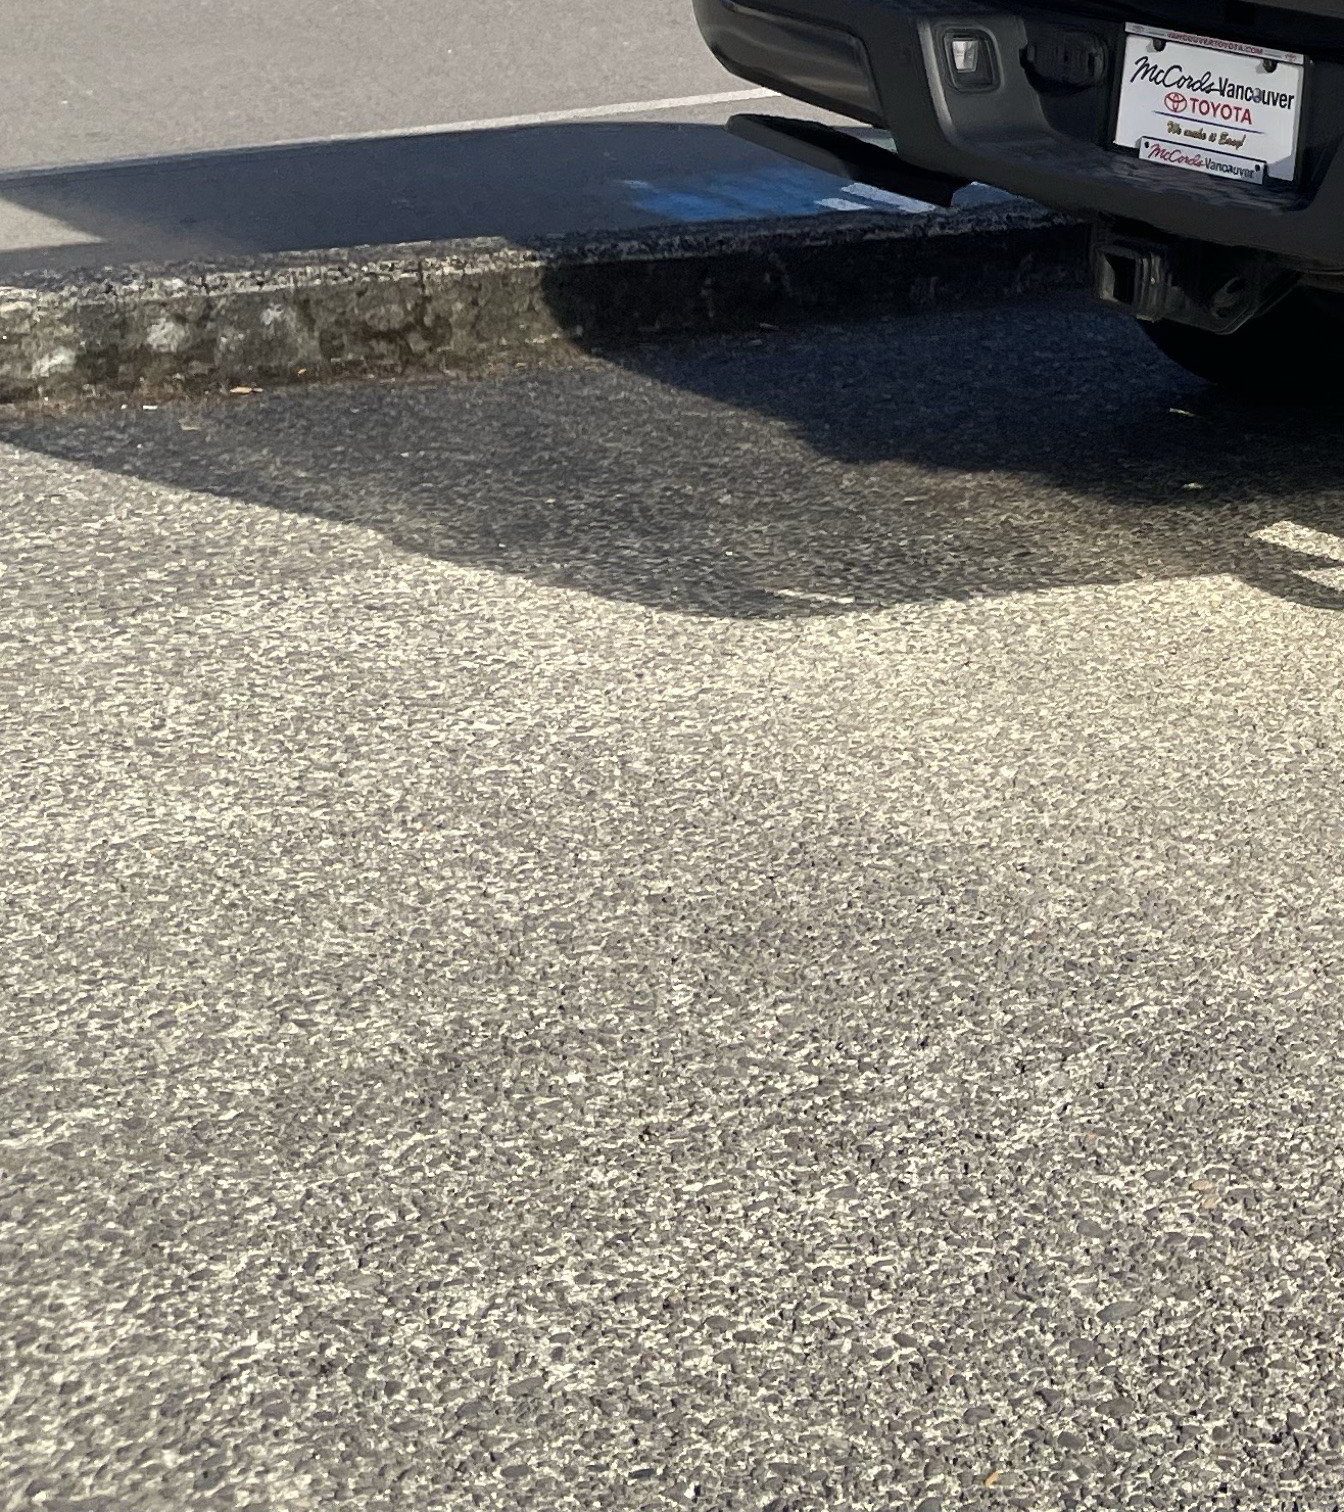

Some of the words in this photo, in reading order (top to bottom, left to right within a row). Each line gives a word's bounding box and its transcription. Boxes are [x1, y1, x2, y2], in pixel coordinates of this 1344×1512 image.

[1129, 55, 1219, 95] McCords
[1217, 76, 1295, 110] Vancouver
[1189, 97, 1253, 125] TOYOTA
[1147, 143, 1207, 168] McCords
[1205, 156, 1256, 180] Vancouver
